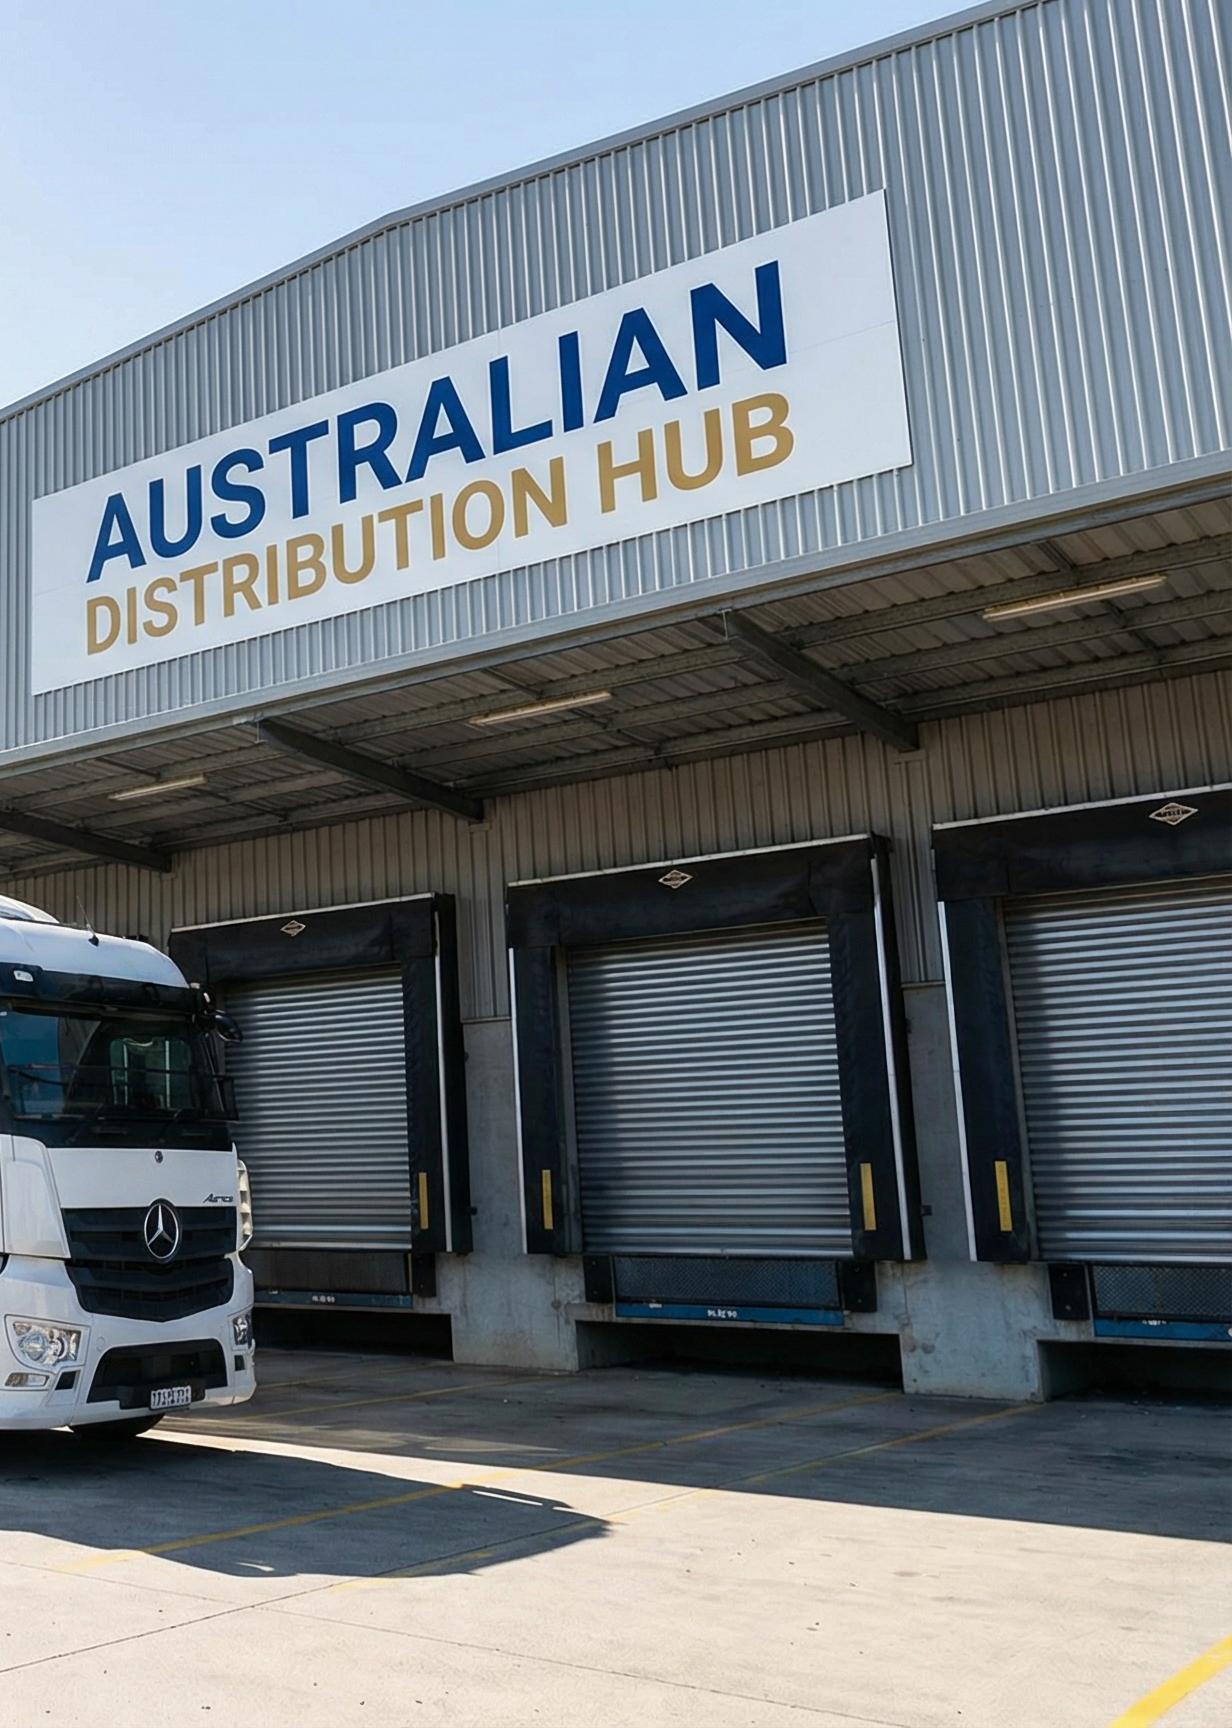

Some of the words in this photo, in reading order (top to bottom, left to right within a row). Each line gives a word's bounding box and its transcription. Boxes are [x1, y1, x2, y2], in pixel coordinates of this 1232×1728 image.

[86, 260, 788, 584] AUSTRALIAN
[86, 457, 568, 656] DISTRIBUTION
[597, 392, 796, 514] HUB
